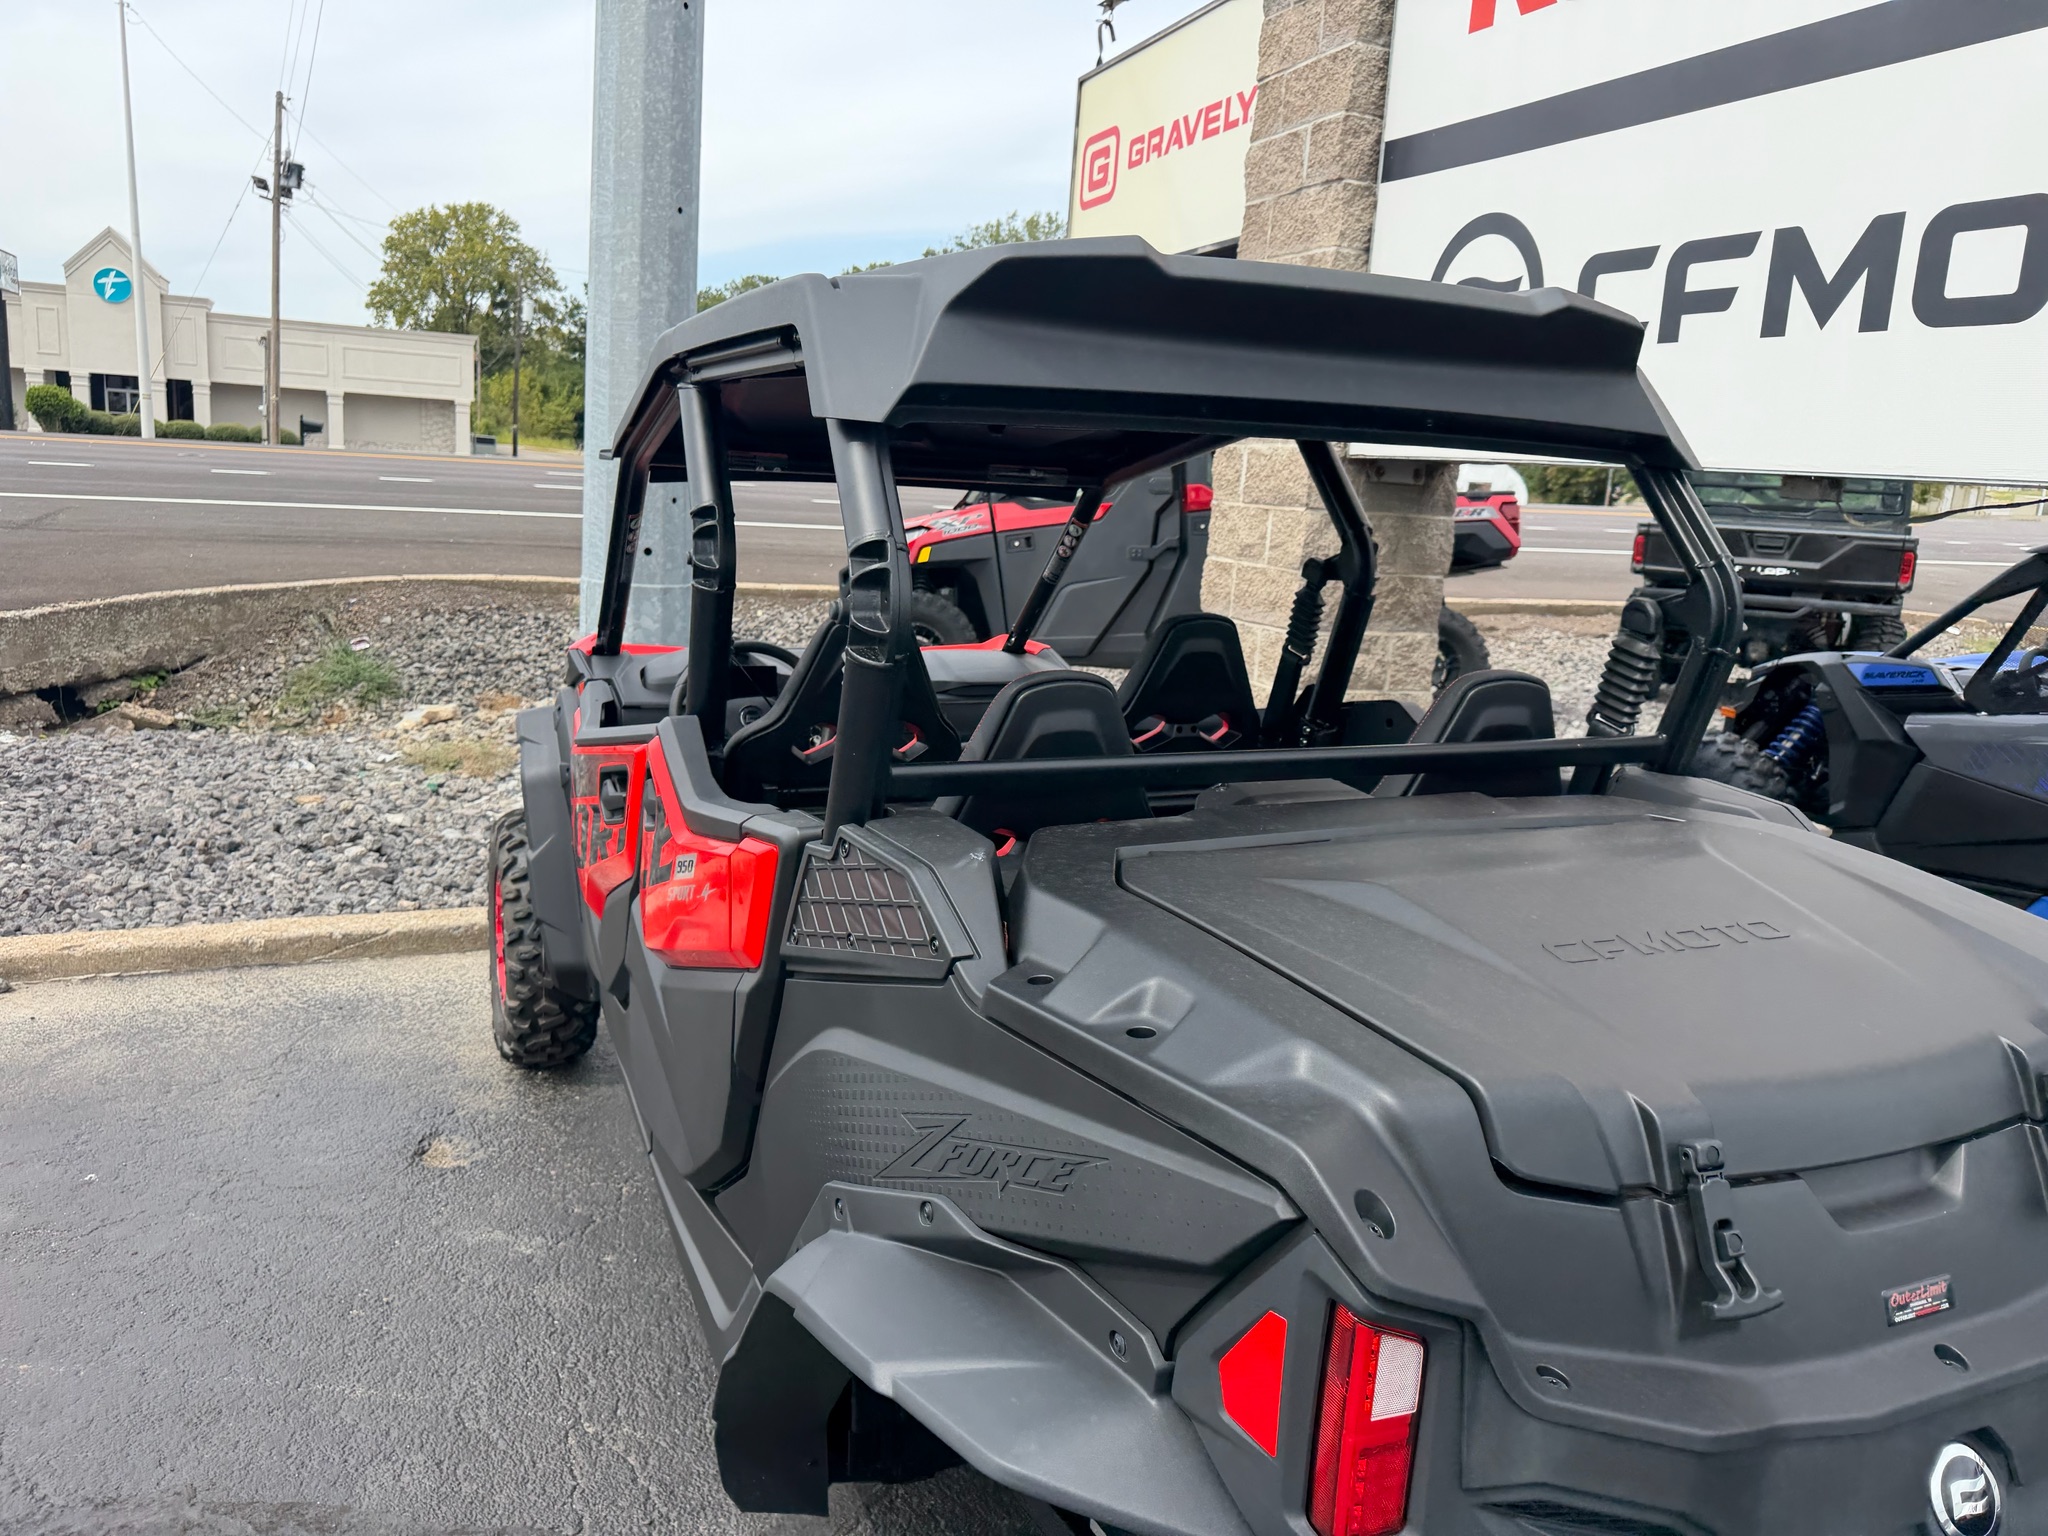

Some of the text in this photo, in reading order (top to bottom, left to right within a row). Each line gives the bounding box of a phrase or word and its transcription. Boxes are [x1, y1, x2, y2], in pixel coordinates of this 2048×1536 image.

[1127, 84, 1259, 170] GRAVELY
[1863, 670, 1927, 680] MAVERICK
[677, 859, 695, 874] 950
[1541, 921, 1791, 964] CFMOTO
